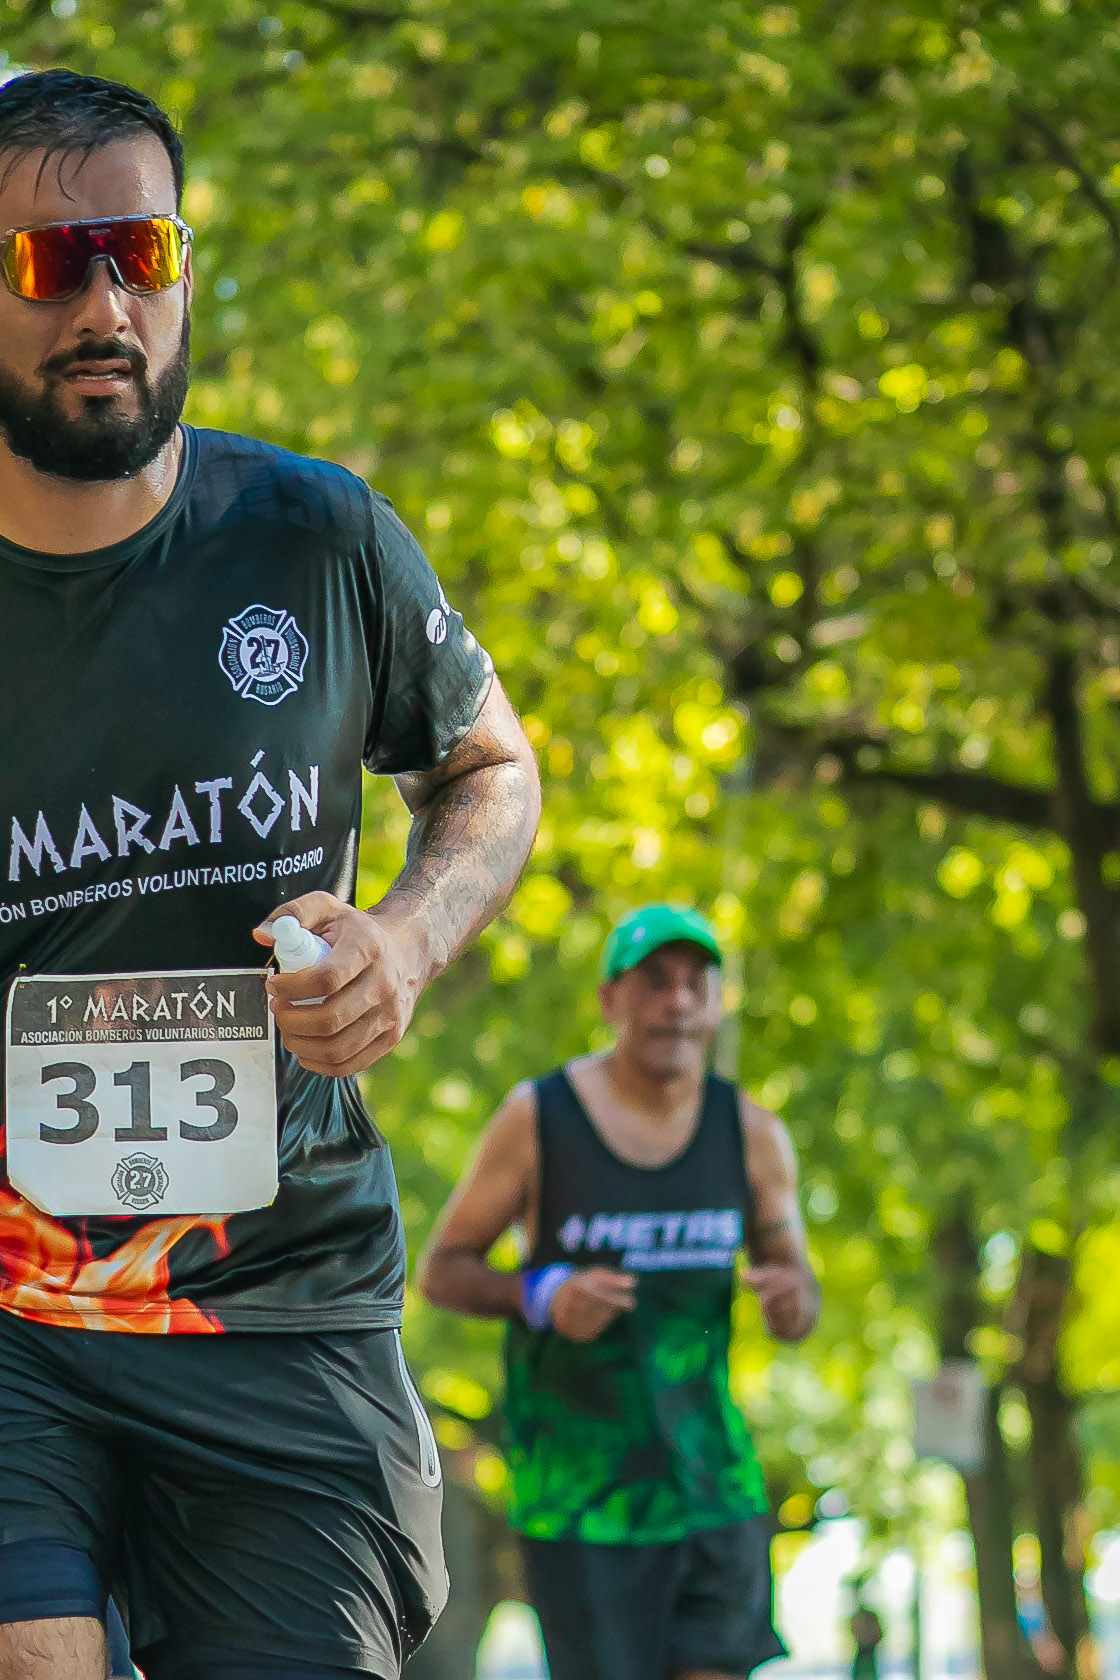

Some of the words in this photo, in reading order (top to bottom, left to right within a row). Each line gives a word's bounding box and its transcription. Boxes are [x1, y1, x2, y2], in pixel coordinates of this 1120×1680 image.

[246, 636, 281, 670] 27
[8, 749, 320, 882] MARATÓN
[30, 878, 134, 917] BOMBEROS
[136, 863, 268, 896] VOLUNTARIOS
[271, 846, 324, 878] ROSARIO
[82, 982, 237, 1024] MARATÓN
[20, 1028, 83, 1044] ASOCIACIÓN
[85, 1028, 143, 1042] BOMBEROS
[145, 1027, 217, 1041] VOLUNTARIOS
[218, 1025, 265, 1039] ROSARIO
[38, 1058, 239, 1145] 313
[130, 1169, 153, 1191] 27
